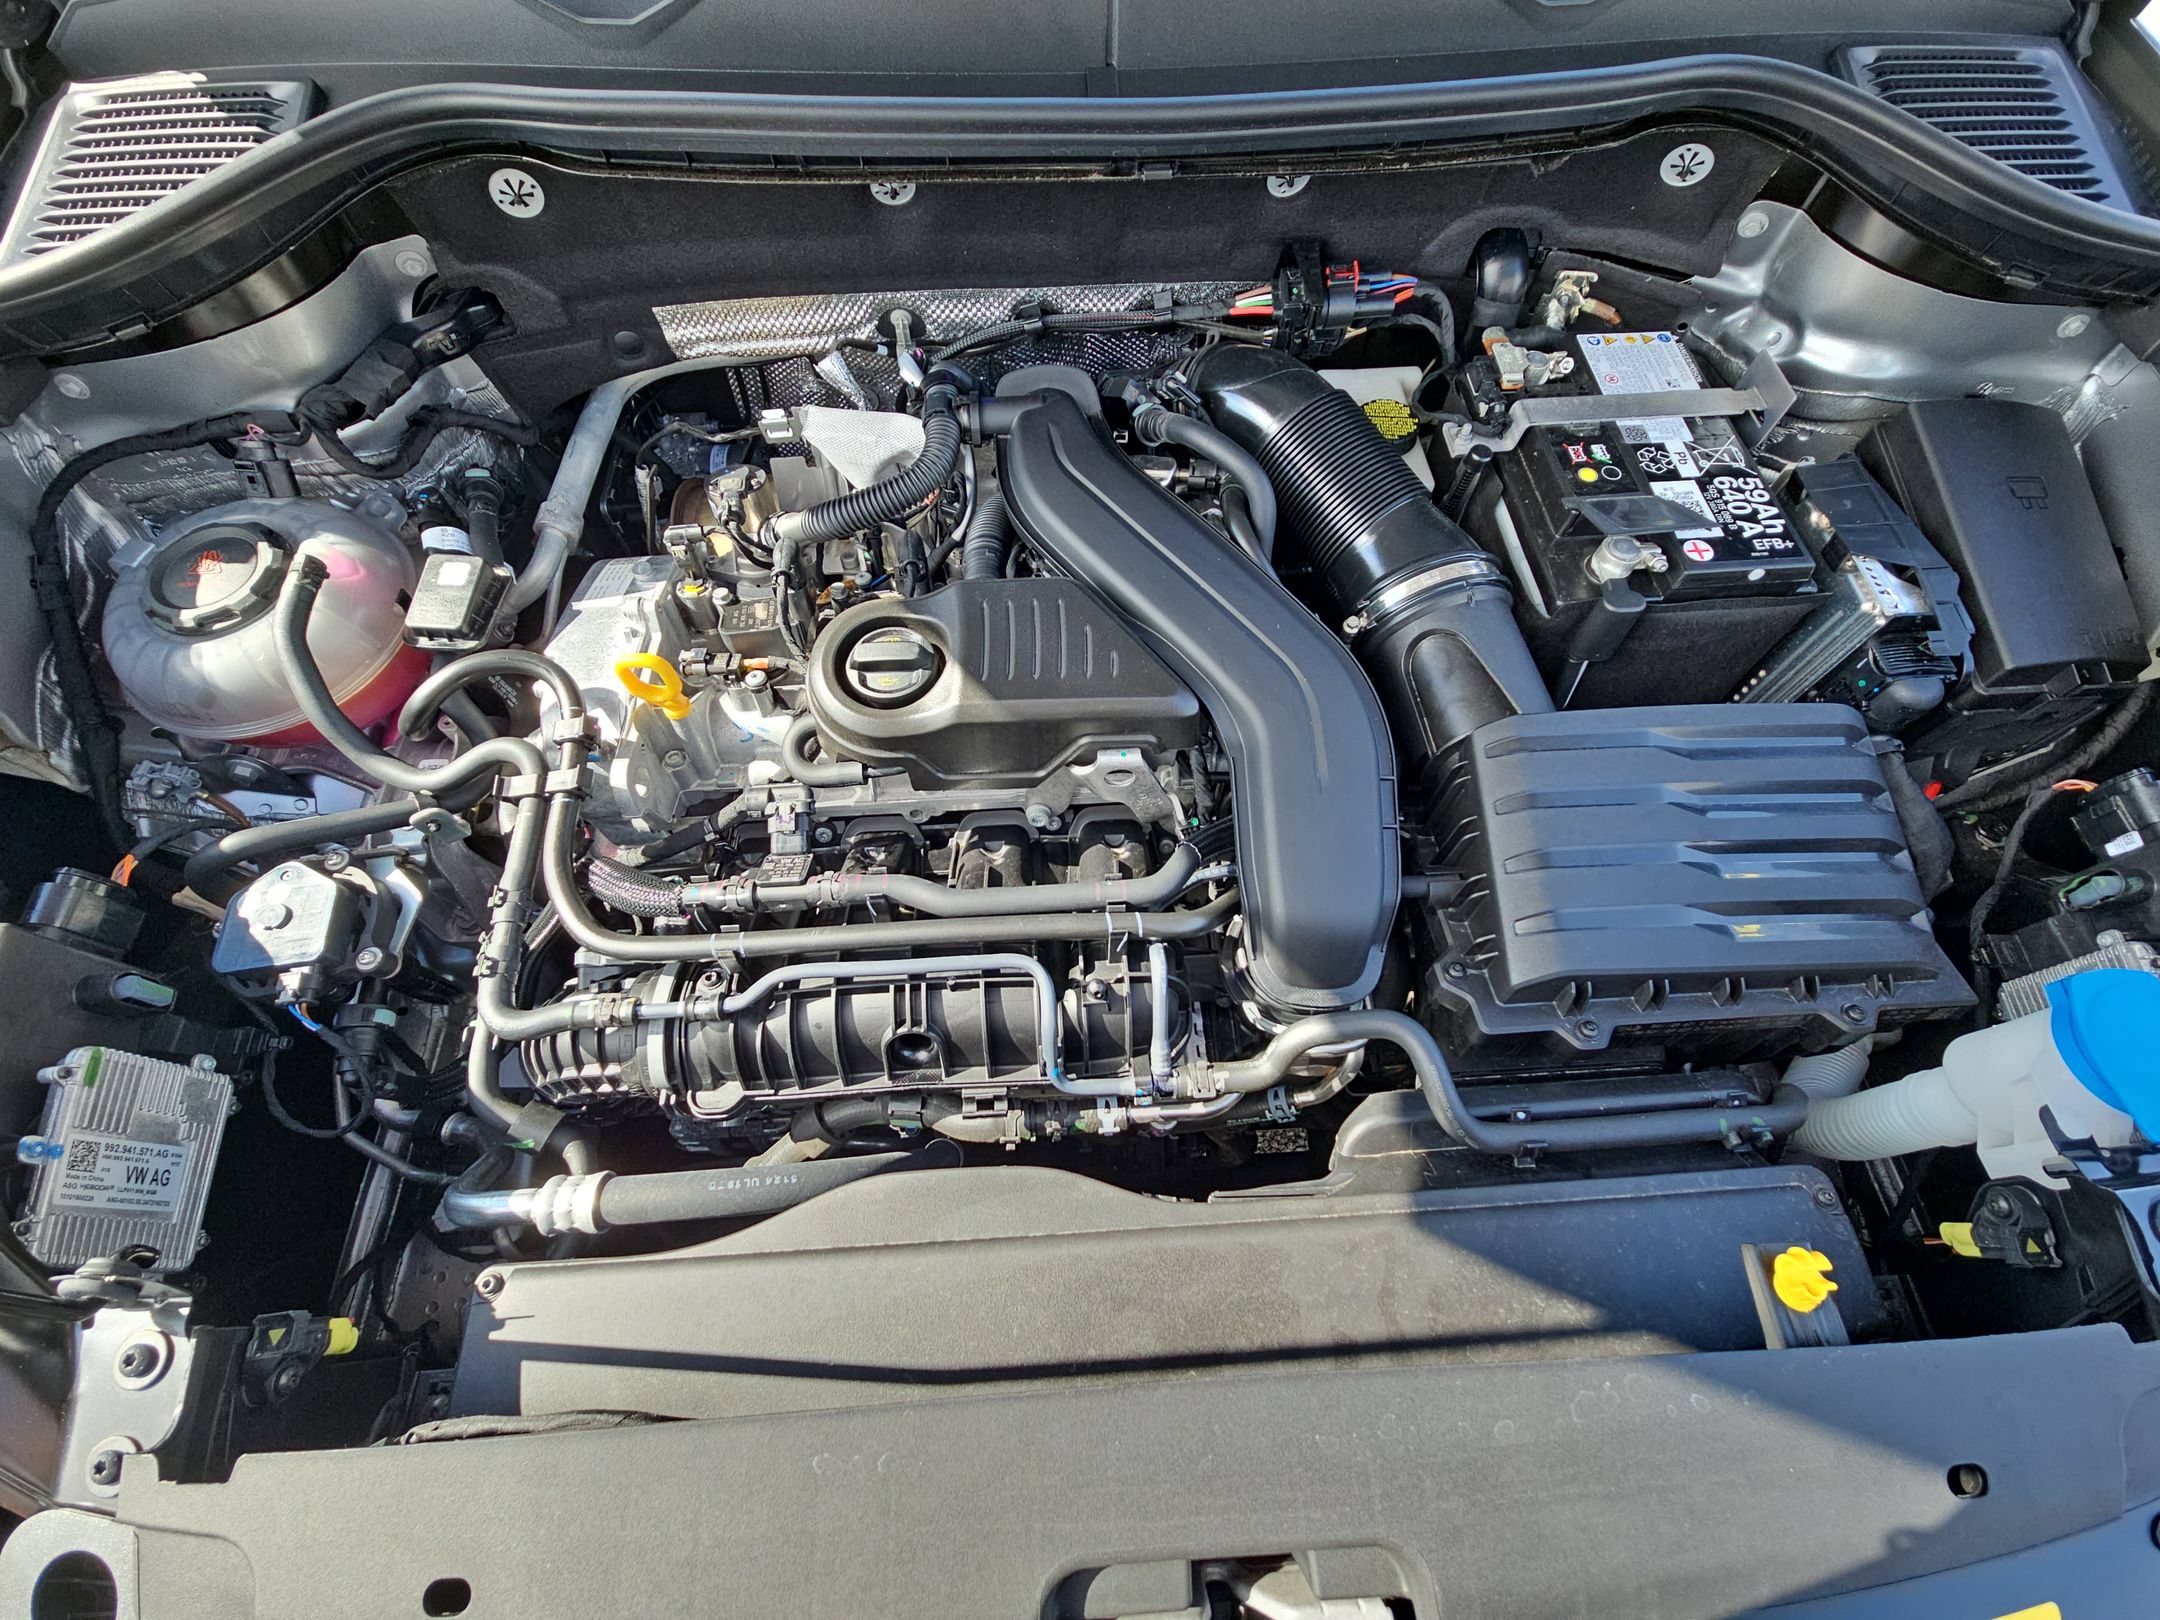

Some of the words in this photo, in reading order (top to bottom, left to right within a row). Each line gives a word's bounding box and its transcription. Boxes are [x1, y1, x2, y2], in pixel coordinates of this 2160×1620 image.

[1674, 451, 1688, 465] Pb
[1713, 476, 1753, 515] 640
[1735, 520, 1765, 538] A
[1715, 499, 1727, 510] 915
[1737, 477, 1786, 534] 59Ah
[1752, 538, 1795, 550] EFB+
[104, 1142, 169, 1159] 992.941.571.AG
[126, 1165, 149, 1185] VW
[149, 1169, 172, 1187] AG
